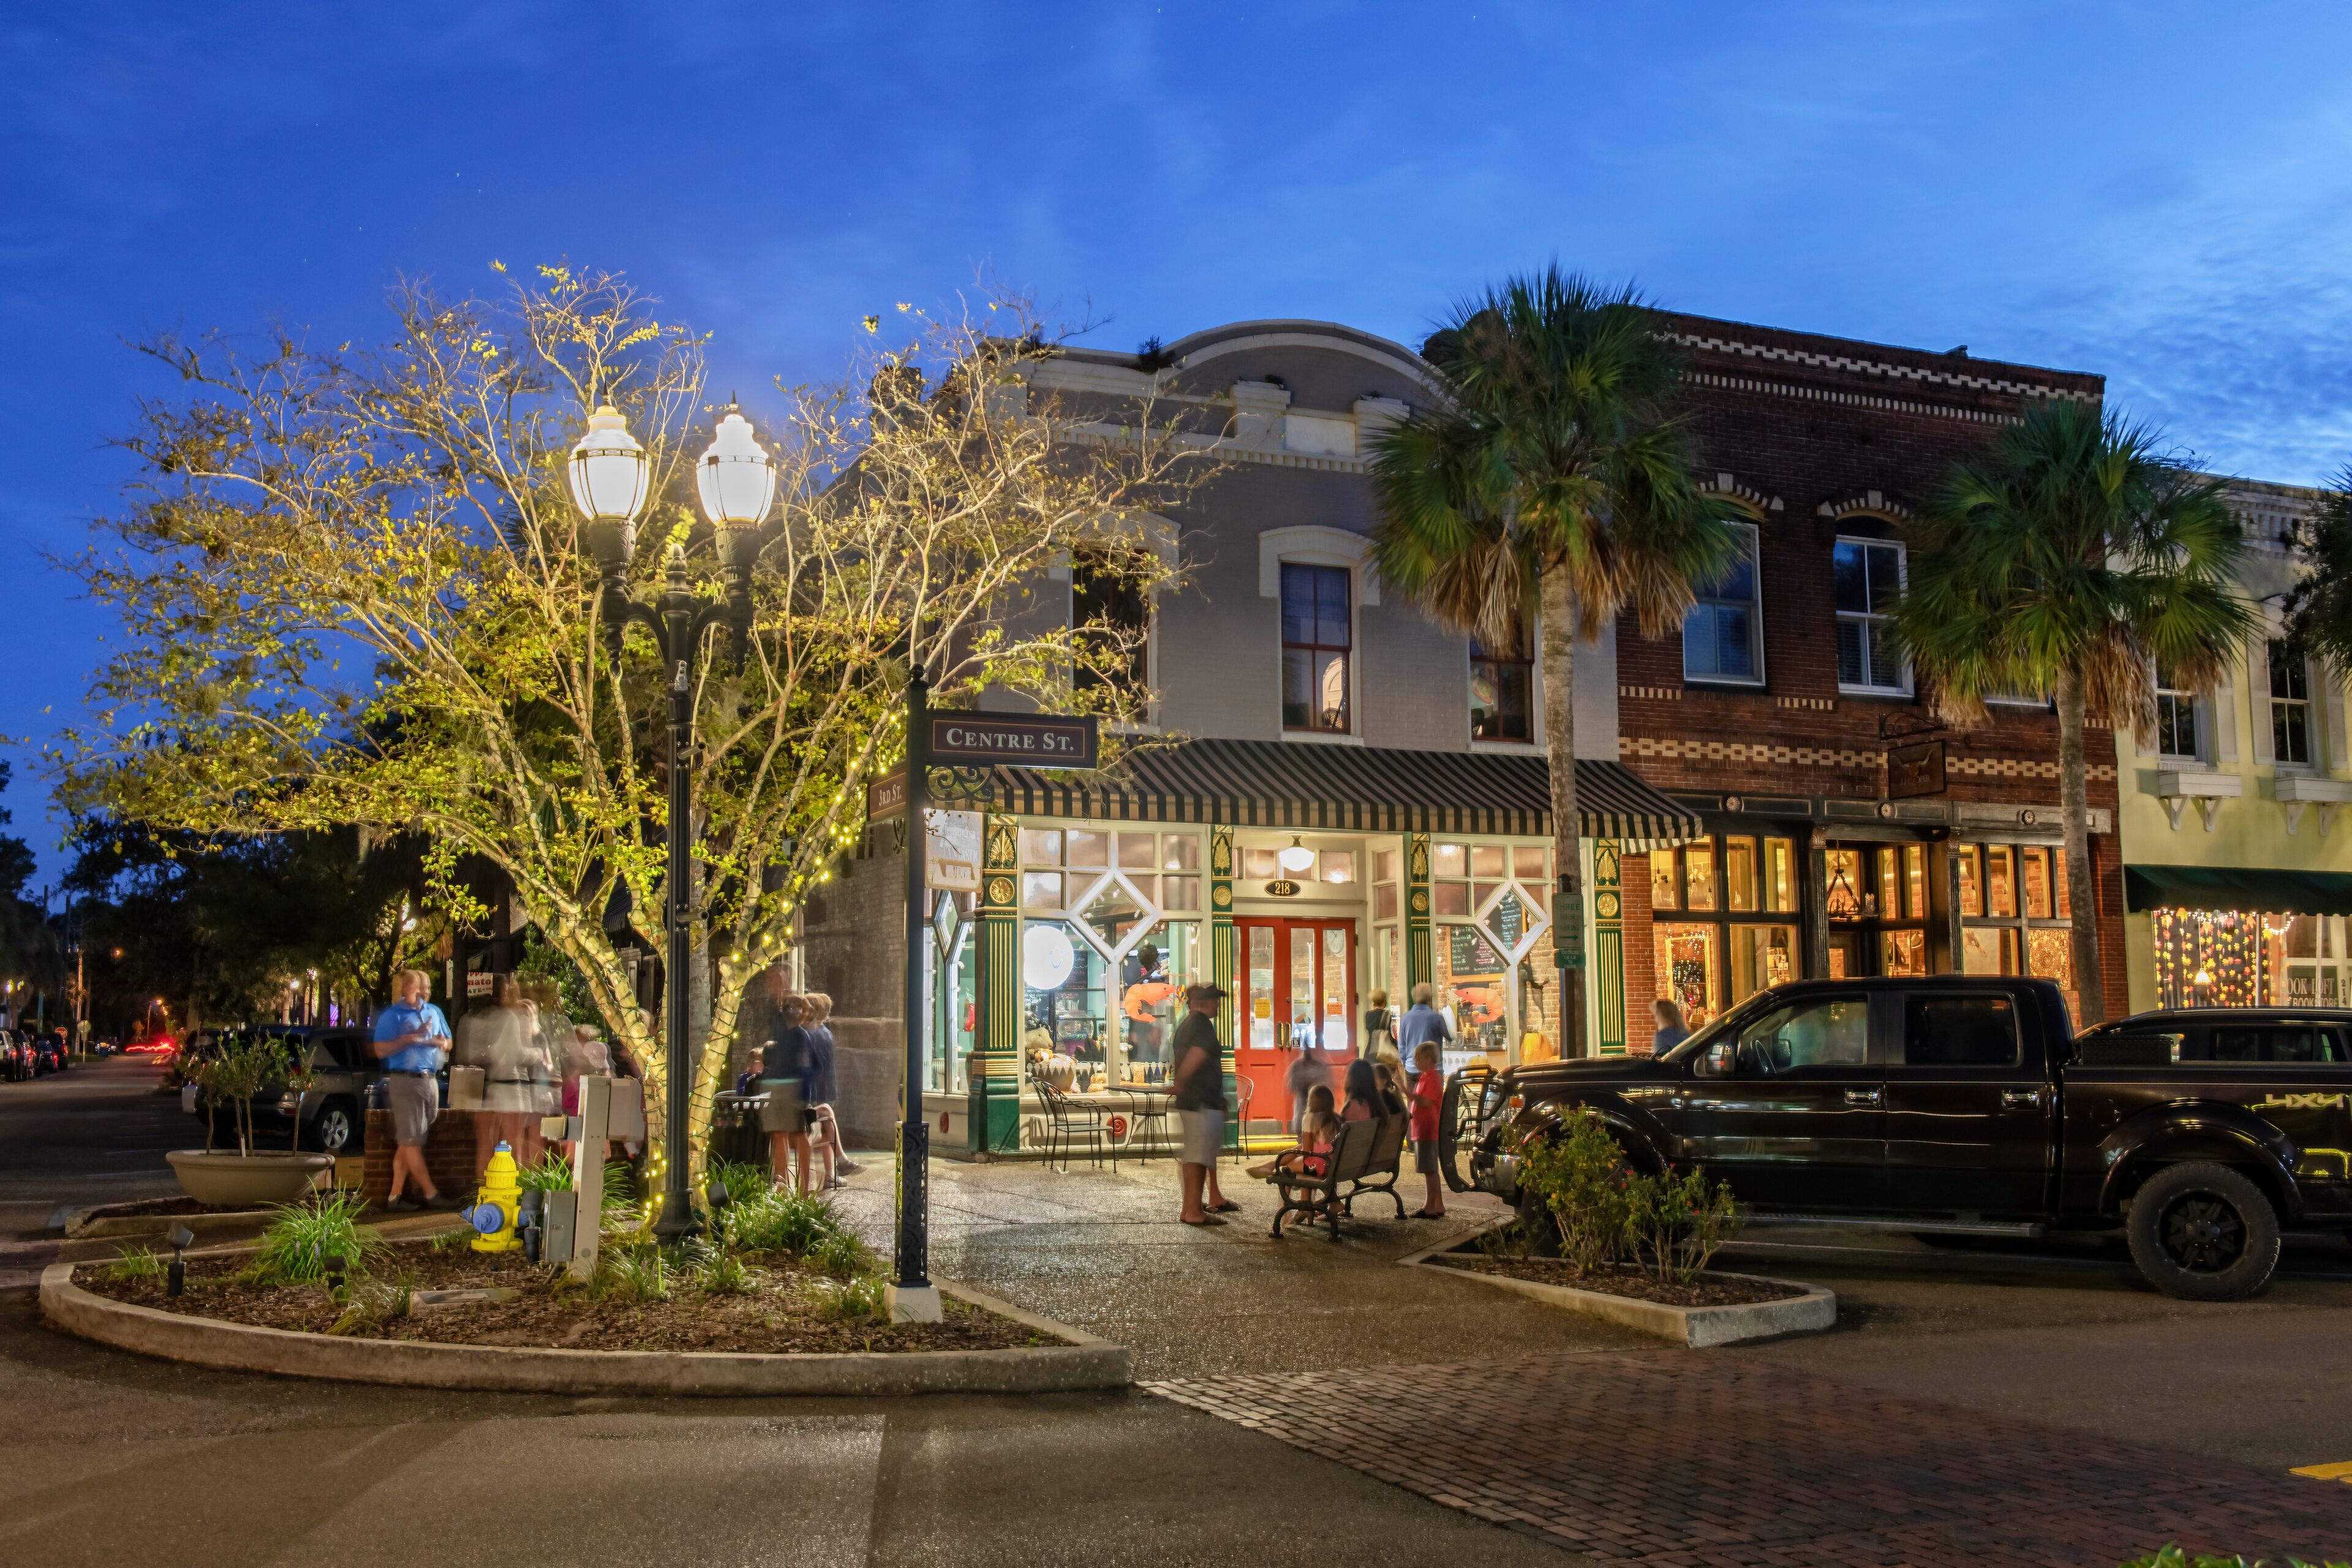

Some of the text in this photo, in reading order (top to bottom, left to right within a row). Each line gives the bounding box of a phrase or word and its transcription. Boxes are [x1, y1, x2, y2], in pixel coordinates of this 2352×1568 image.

[946, 728, 1074, 750] CENTRE ST.
[878, 784, 902, 807] 3RD ST.
[1275, 882, 1290, 894] 218
[2288, 978, 2335, 995] OOK LOFT
[2265, 1093, 2344, 1107] 4X4
